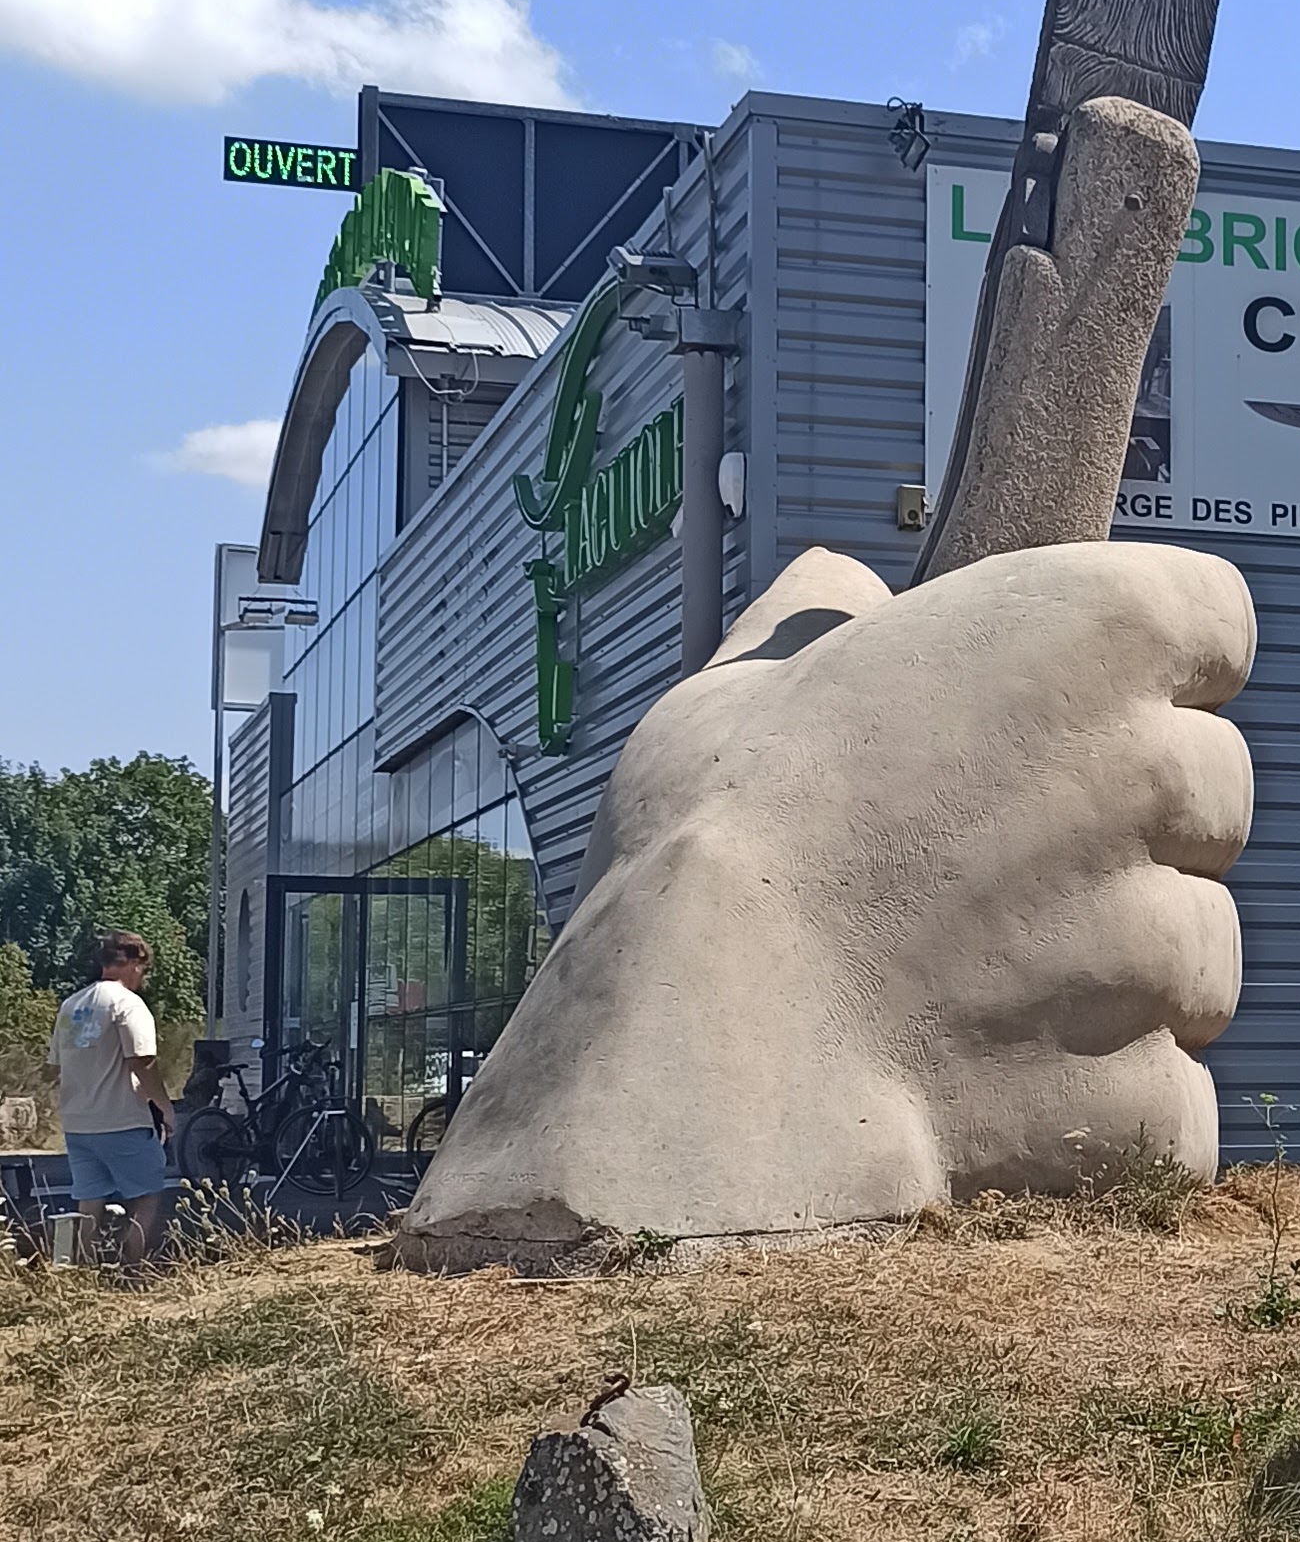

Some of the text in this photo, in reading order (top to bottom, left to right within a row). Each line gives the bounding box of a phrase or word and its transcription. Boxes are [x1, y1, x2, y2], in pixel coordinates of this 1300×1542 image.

[229, 141, 356, 186] OUVERT
[951, 184, 992, 243] L
[1115, 494, 1173, 519] RGE
[1192, 497, 1253, 525] DES
